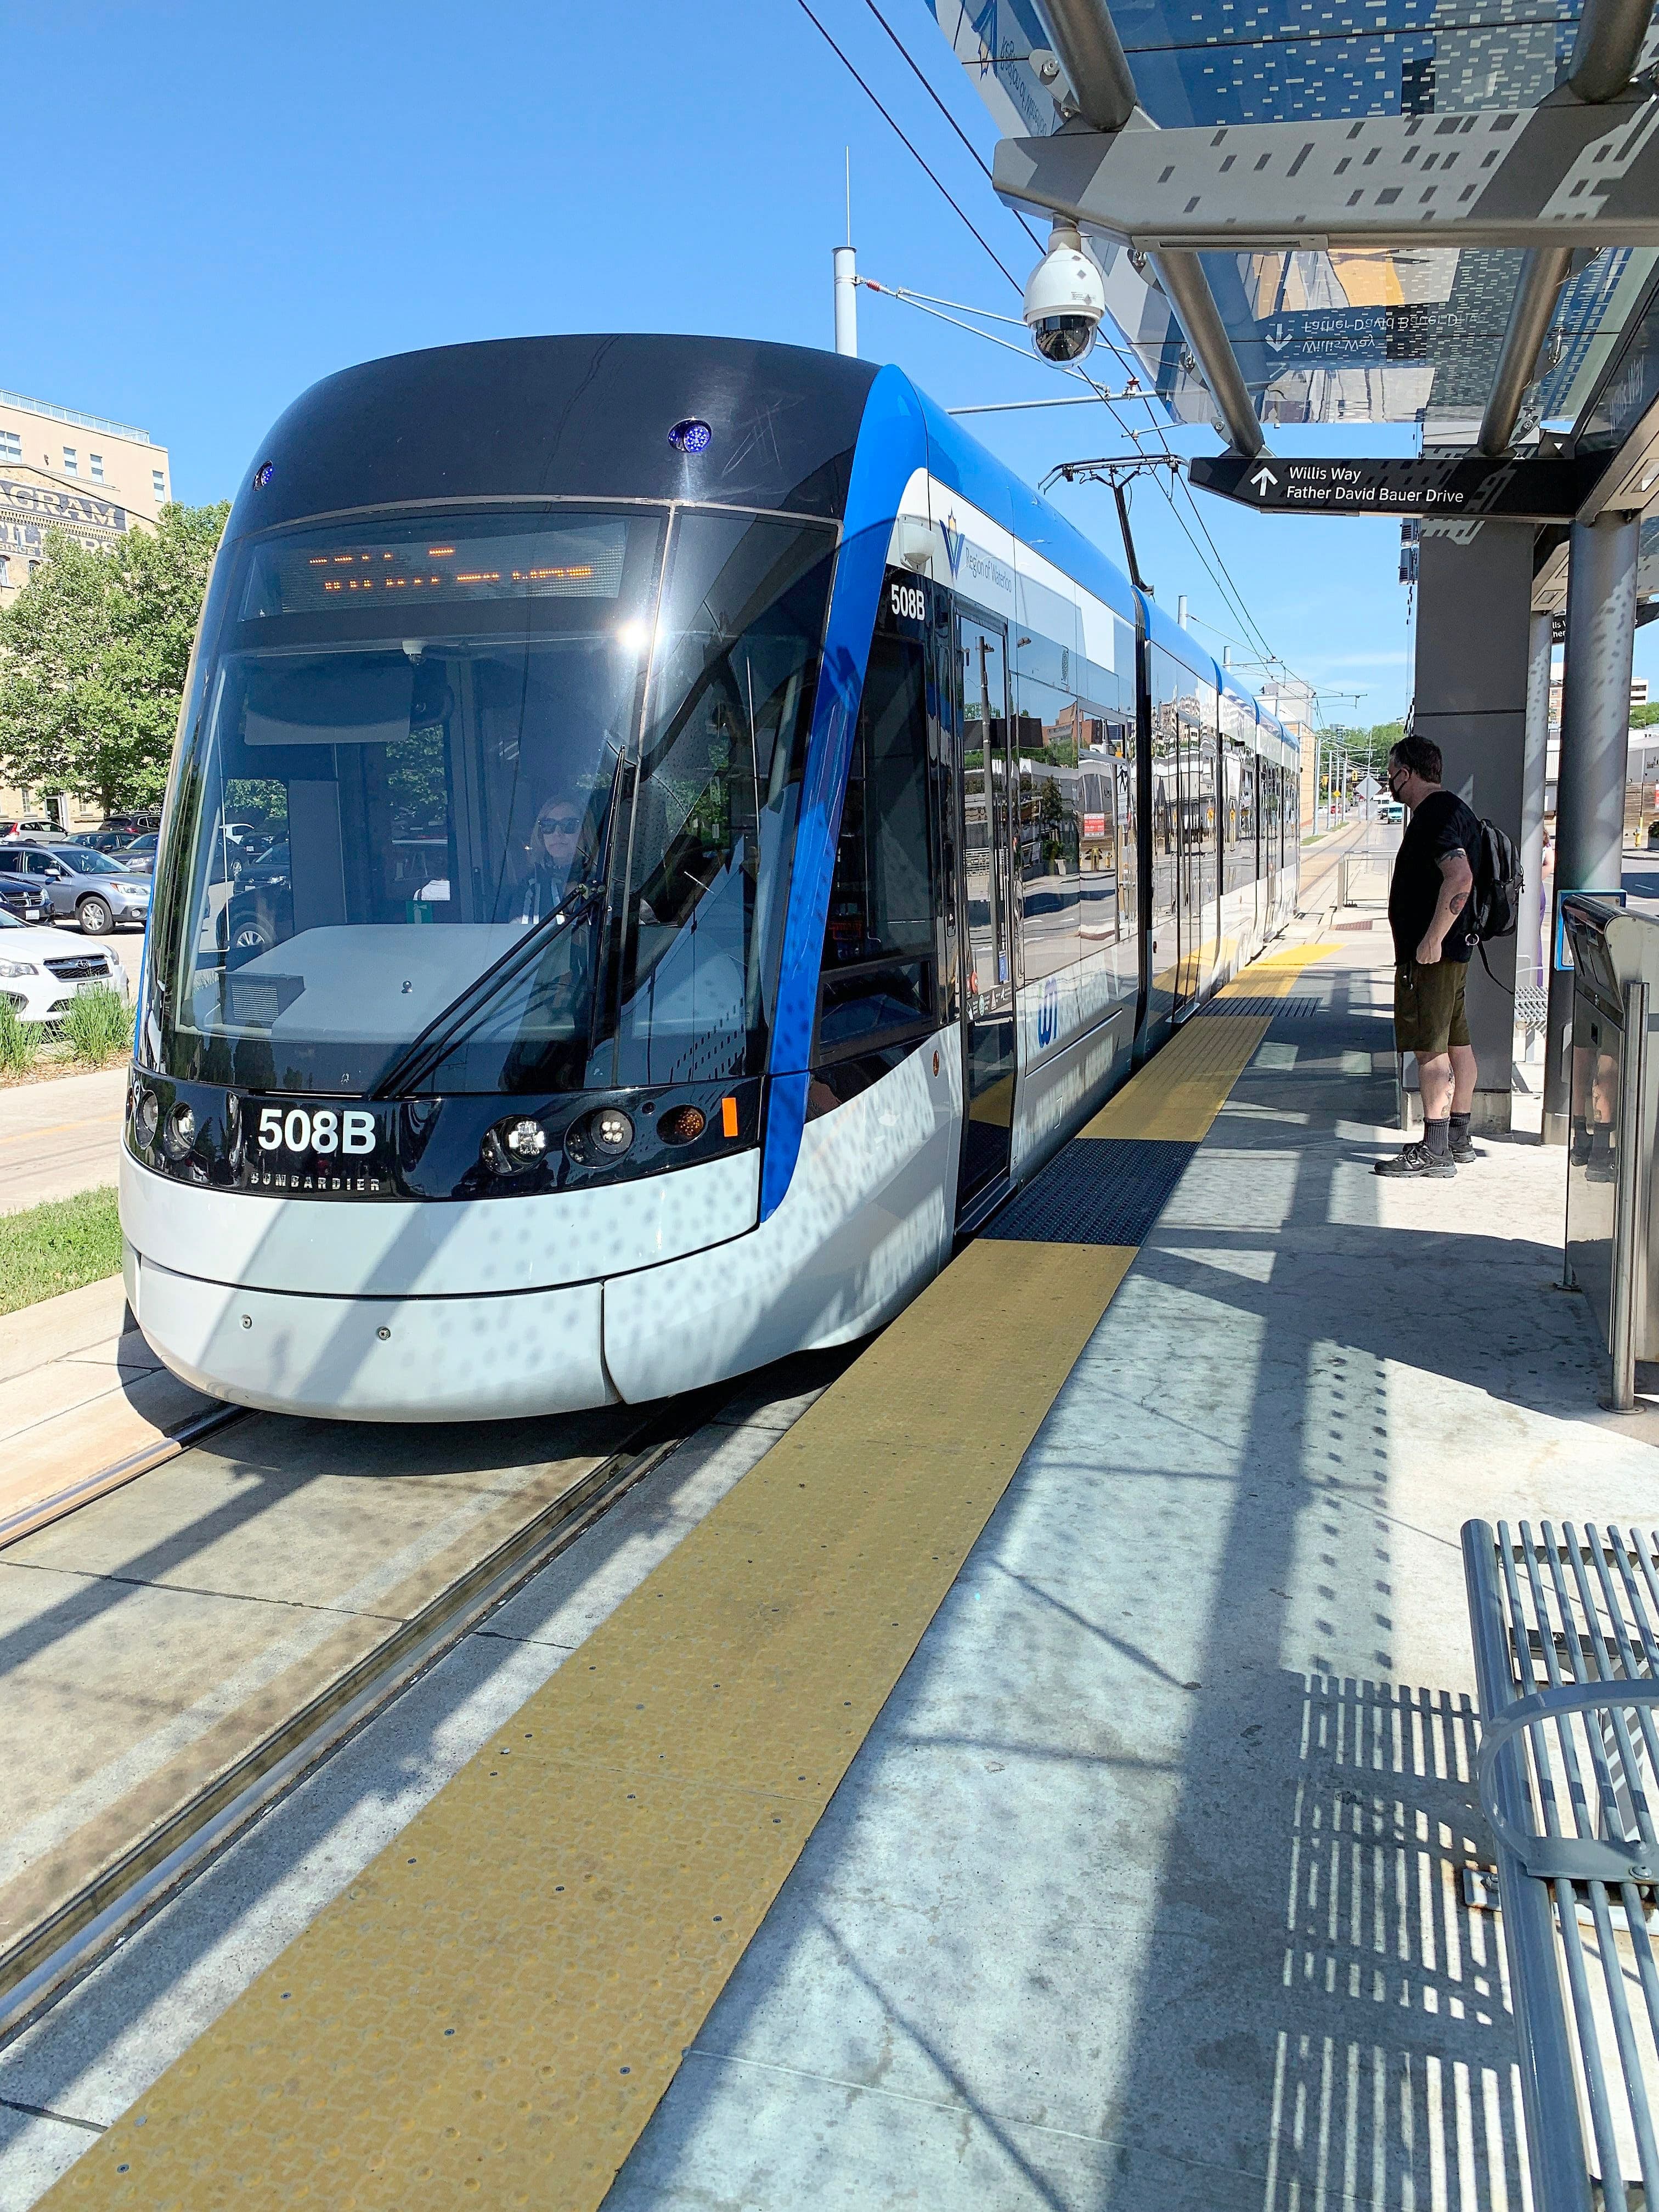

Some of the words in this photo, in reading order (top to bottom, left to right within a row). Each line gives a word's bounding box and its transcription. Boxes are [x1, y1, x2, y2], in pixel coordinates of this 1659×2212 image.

[1290, 466, 1327, 480] Willis
[1331, 467, 1362, 484] Way
[1286, 486, 1332, 499] Father
[1335, 486, 1375, 501] David
[1379, 488, 1423, 502] Bauer
[1426, 489, 1464, 502] Drive
[966, 547, 984, 578] Region
[985, 561, 990, 579] of
[991, 563, 1012, 593] Waterloo
[891, 584, 925, 621] 508B
[258, 1108, 376, 1154] 508B
[251, 1172, 380, 1191] BOMBARDIER
